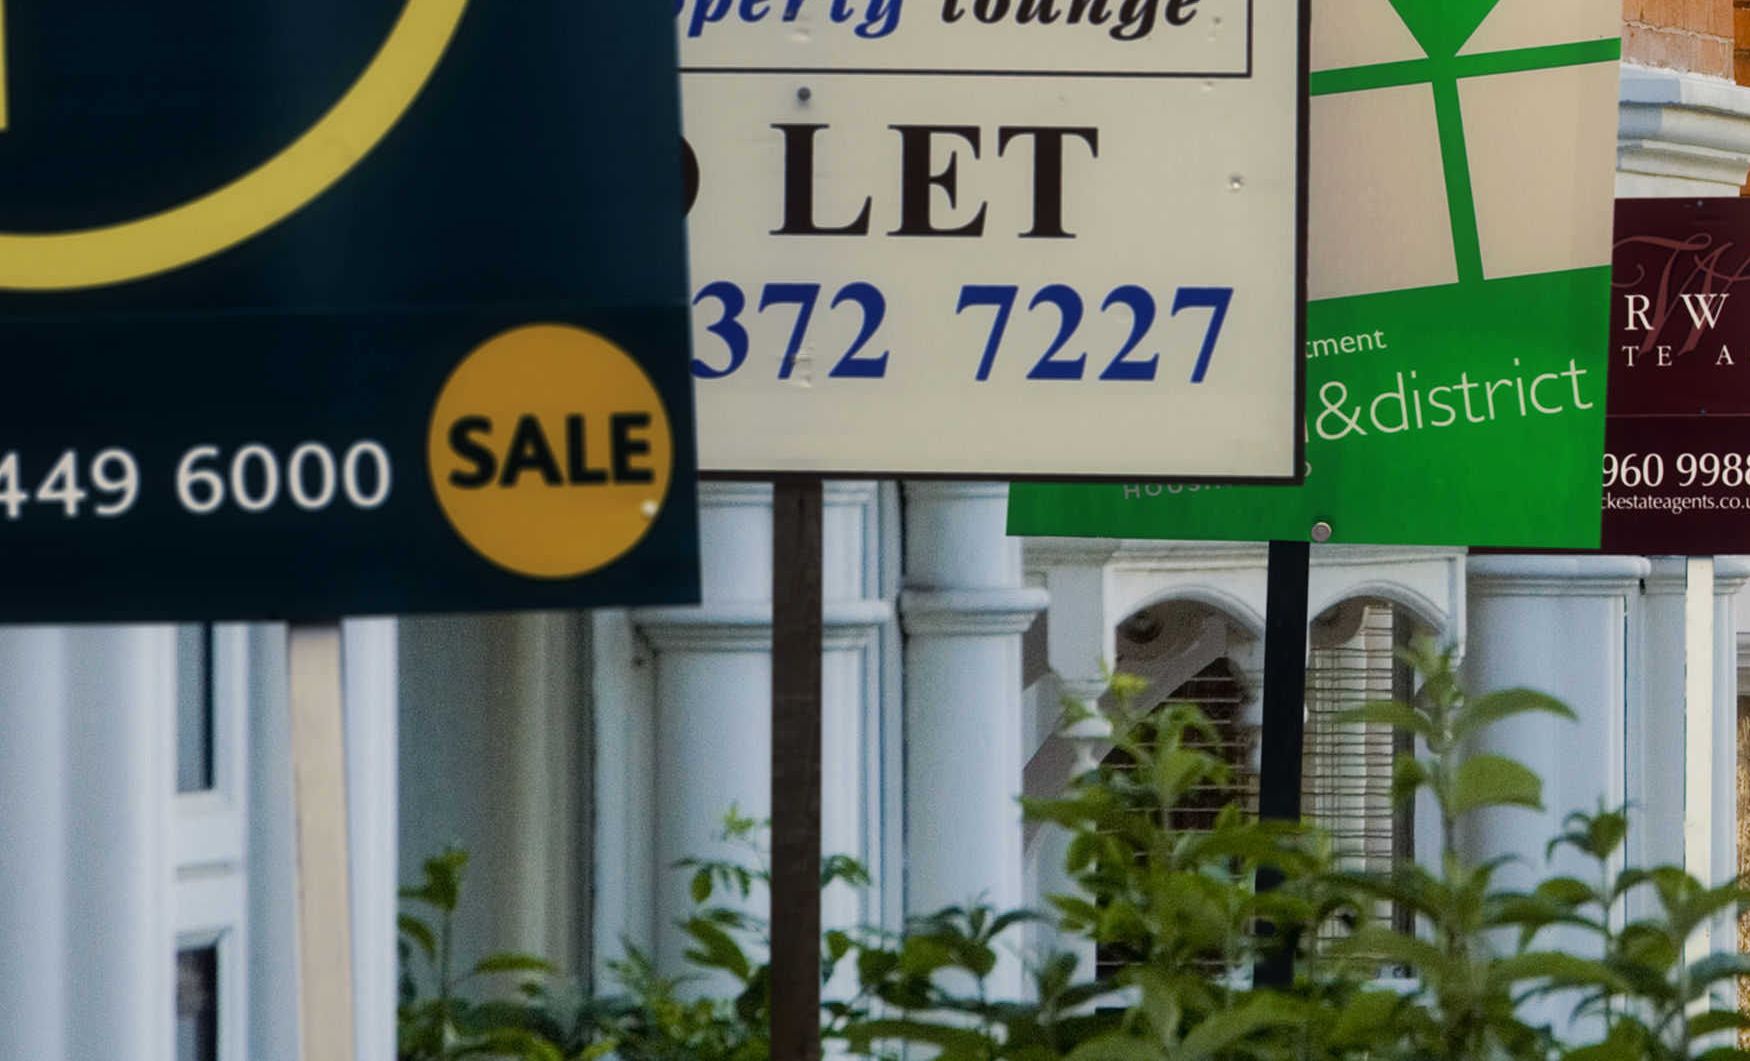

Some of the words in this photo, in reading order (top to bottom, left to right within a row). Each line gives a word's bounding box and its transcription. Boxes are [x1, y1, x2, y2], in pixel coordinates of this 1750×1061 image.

[769, 123, 1099, 239] LET
[690, 281, 890, 379] 372
[955, 284, 1234, 383] 7227
[176, 440, 392, 513] 6000
[446, 411, 657, 490] SALE
[1602, 453, 1664, 487] 960
